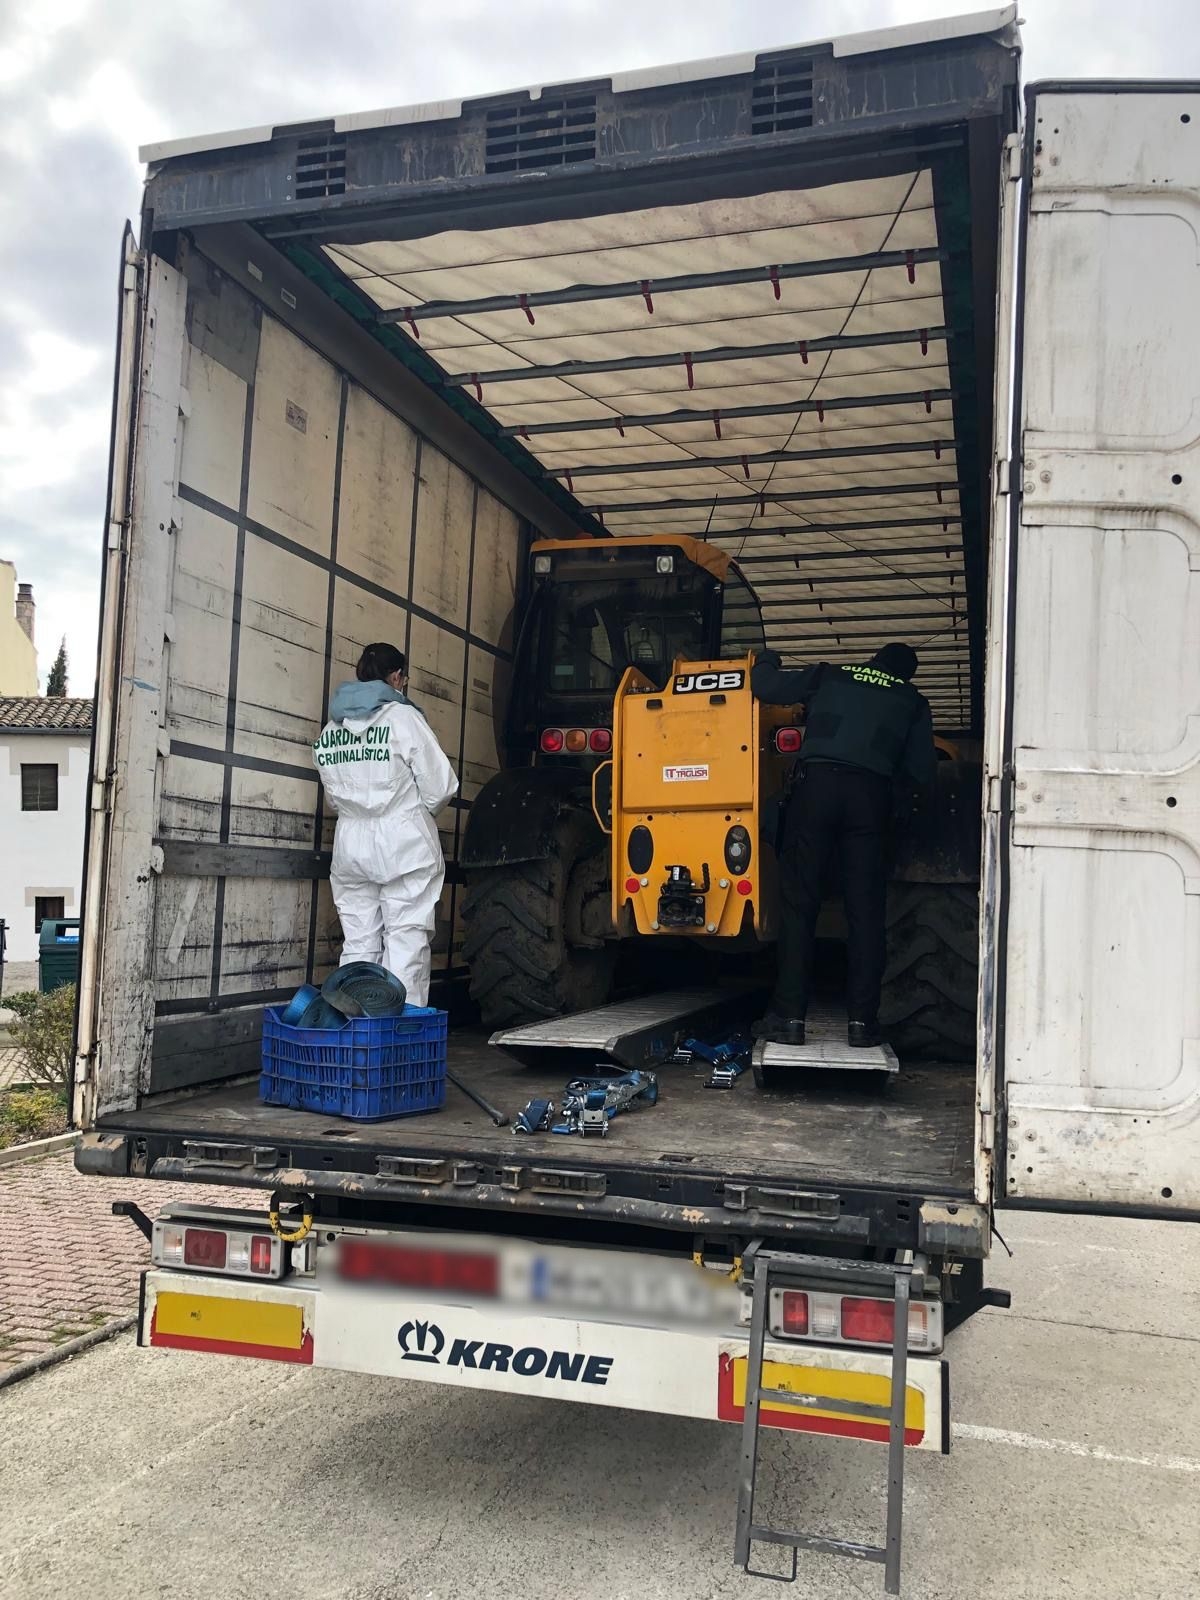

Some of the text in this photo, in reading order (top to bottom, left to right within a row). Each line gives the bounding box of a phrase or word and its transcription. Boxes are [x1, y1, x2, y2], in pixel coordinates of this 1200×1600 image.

[676, 672, 741, 692] JCB
[853, 673, 891, 687] CIVIL
[447, 1338, 614, 1385] KRONE
